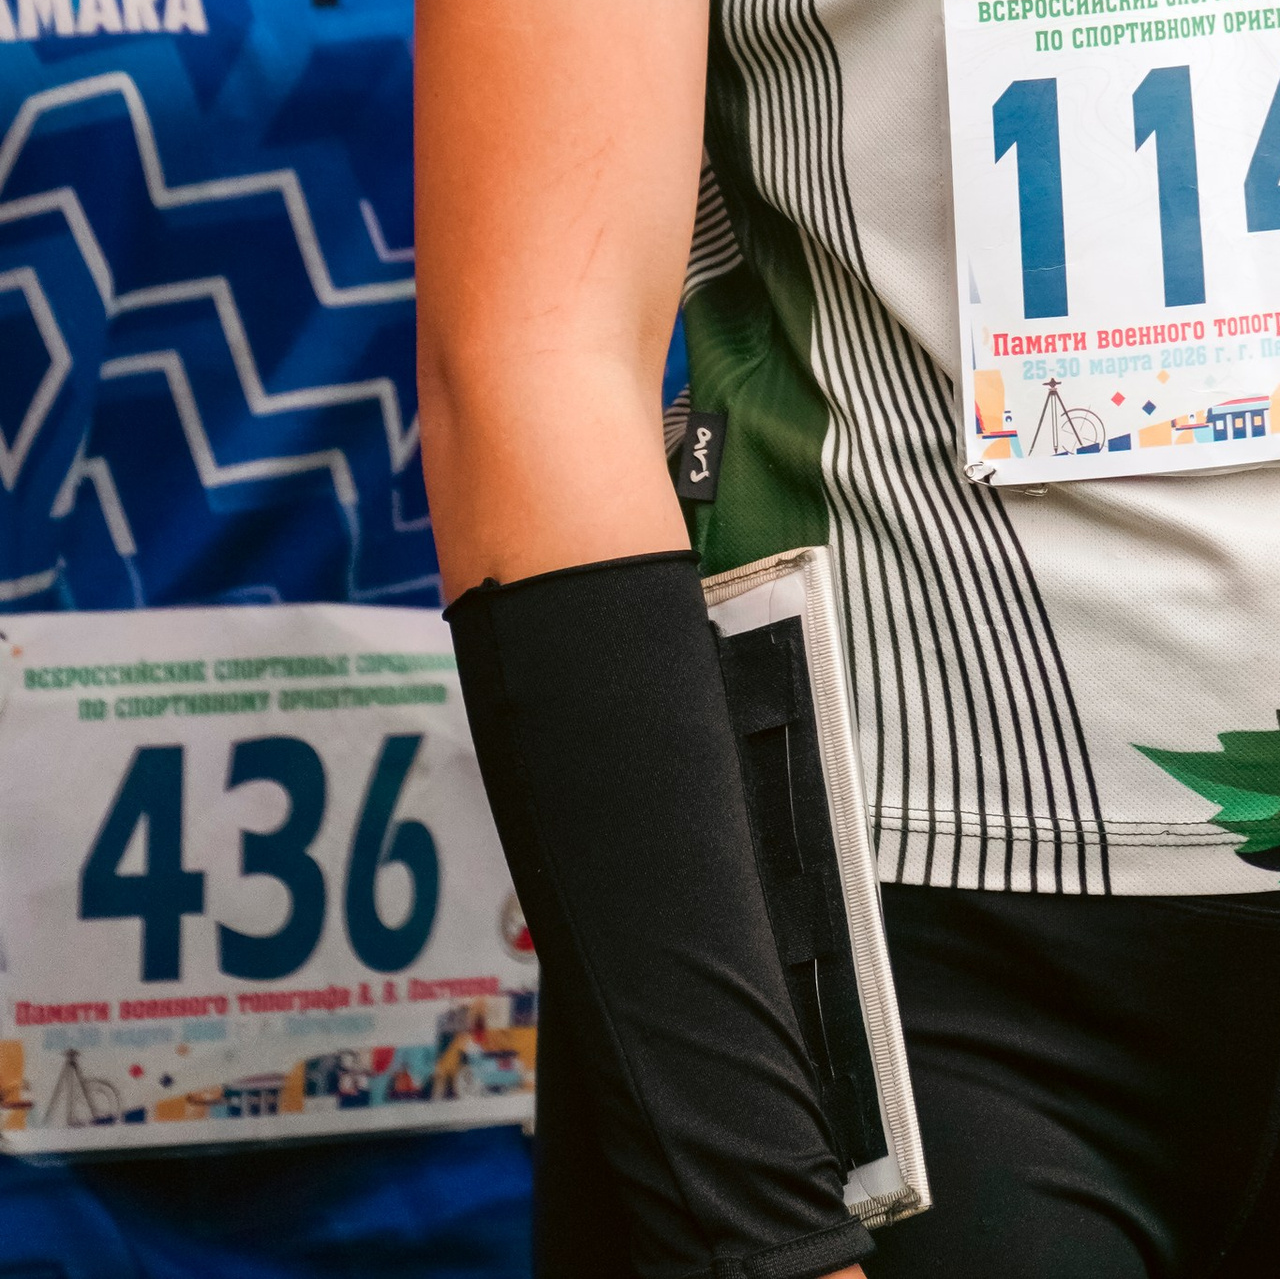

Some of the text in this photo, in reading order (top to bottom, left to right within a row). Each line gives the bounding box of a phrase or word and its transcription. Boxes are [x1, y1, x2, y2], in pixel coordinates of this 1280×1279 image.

[1035, 29, 1063, 52] ПО
[1072, 13, 1216, 50] СПОРТИВНОМУ
[993, 331, 1087, 357] Памяти
[1096, 320, 1205, 350] военного
[1022, 356, 1081, 381] 25-30
[1089, 353, 1153, 379] марта
[1160, 345, 1207, 369] 2026
[1214, 346, 1232, 364] г.
[1238, 343, 1254, 361] г.
[77, 732, 442, 983] 436
